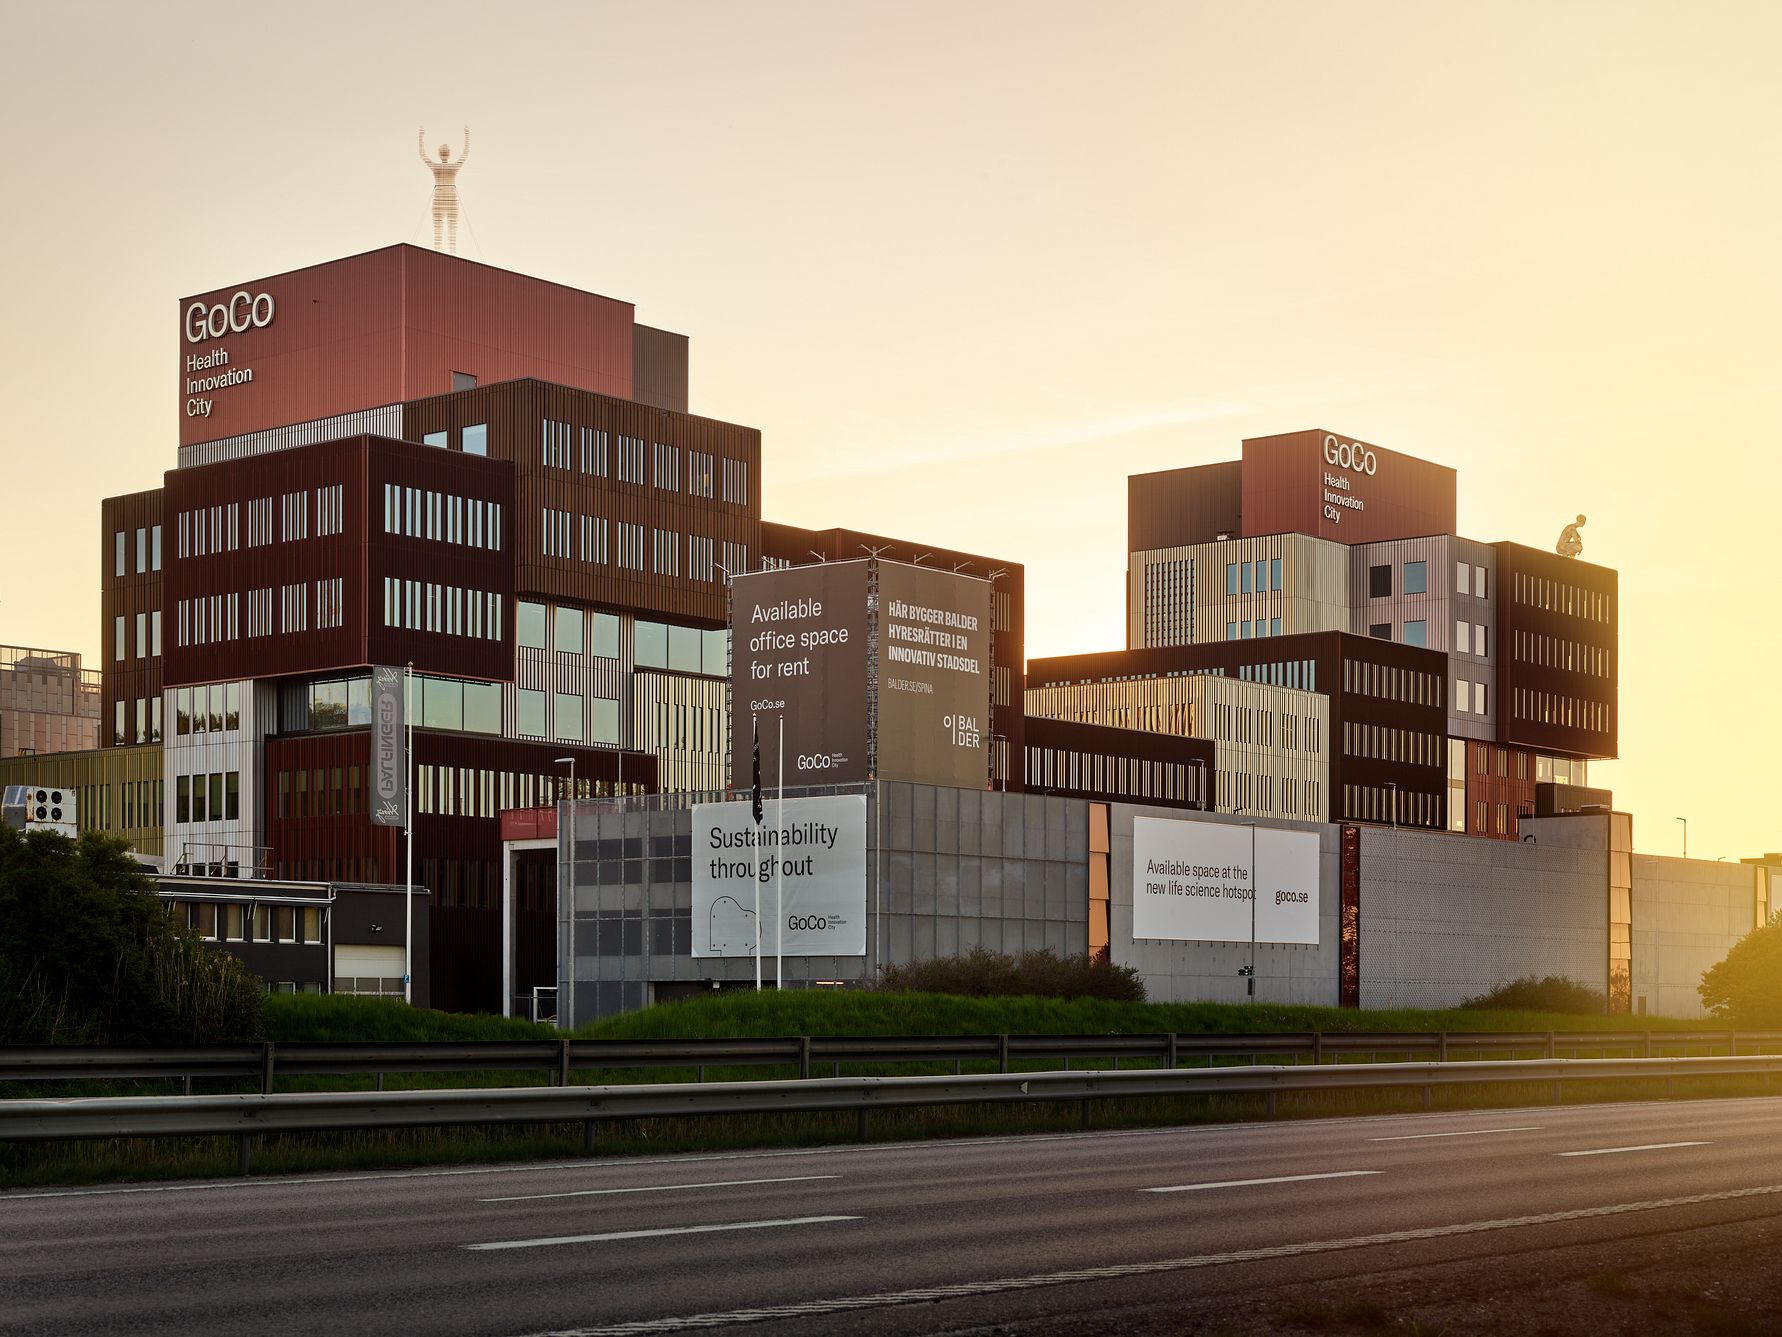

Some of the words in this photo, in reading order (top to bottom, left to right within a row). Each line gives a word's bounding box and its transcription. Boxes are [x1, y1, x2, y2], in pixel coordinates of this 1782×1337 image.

[186, 291, 275, 343] GoCo
[186, 347, 229, 372] Health
[186, 367, 252, 394] Innovation
[186, 398, 212, 417] City
[1324, 435, 1377, 475] GoCo
[1324, 472, 1350, 491] Health
[1324, 488, 1364, 511] Innovation
[1324, 505, 1340, 523] City
[751, 598, 822, 623] Available
[888, 600, 908, 619] HÄR
[909, 605, 944, 625] BYGGER
[945, 612, 978, 631] BALDER
[750, 631, 795, 651] office
[800, 628, 849, 650] space
[888, 624, 951, 648] HYRESRÄTTER
[957, 637, 968, 650] EN
[750, 660, 773, 680] for
[777, 657, 809, 677] rent
[888, 646, 936, 667] INNOVATIV
[937, 653, 980, 674] STADSDEL
[750, 699, 785, 711] GoCo.se
[958, 715, 980, 732] BAL
[958, 731, 980, 748] DER
[797, 753, 831, 770] GoCo
[709, 822, 838, 849] Sustainability
[709, 855, 813, 883] throughout
[1147, 859, 1190, 877] Available
[1192, 865, 1219, 880] space
[1221, 866, 1231, 879] at
[1233, 865, 1248, 880] the
[1146, 882, 1166, 895] new
[1168, 880, 1183, 896] life
[1185, 882, 1220, 898] science
[1275, 890, 1309, 905] goco.se
[788, 914, 827, 930] GoCo
